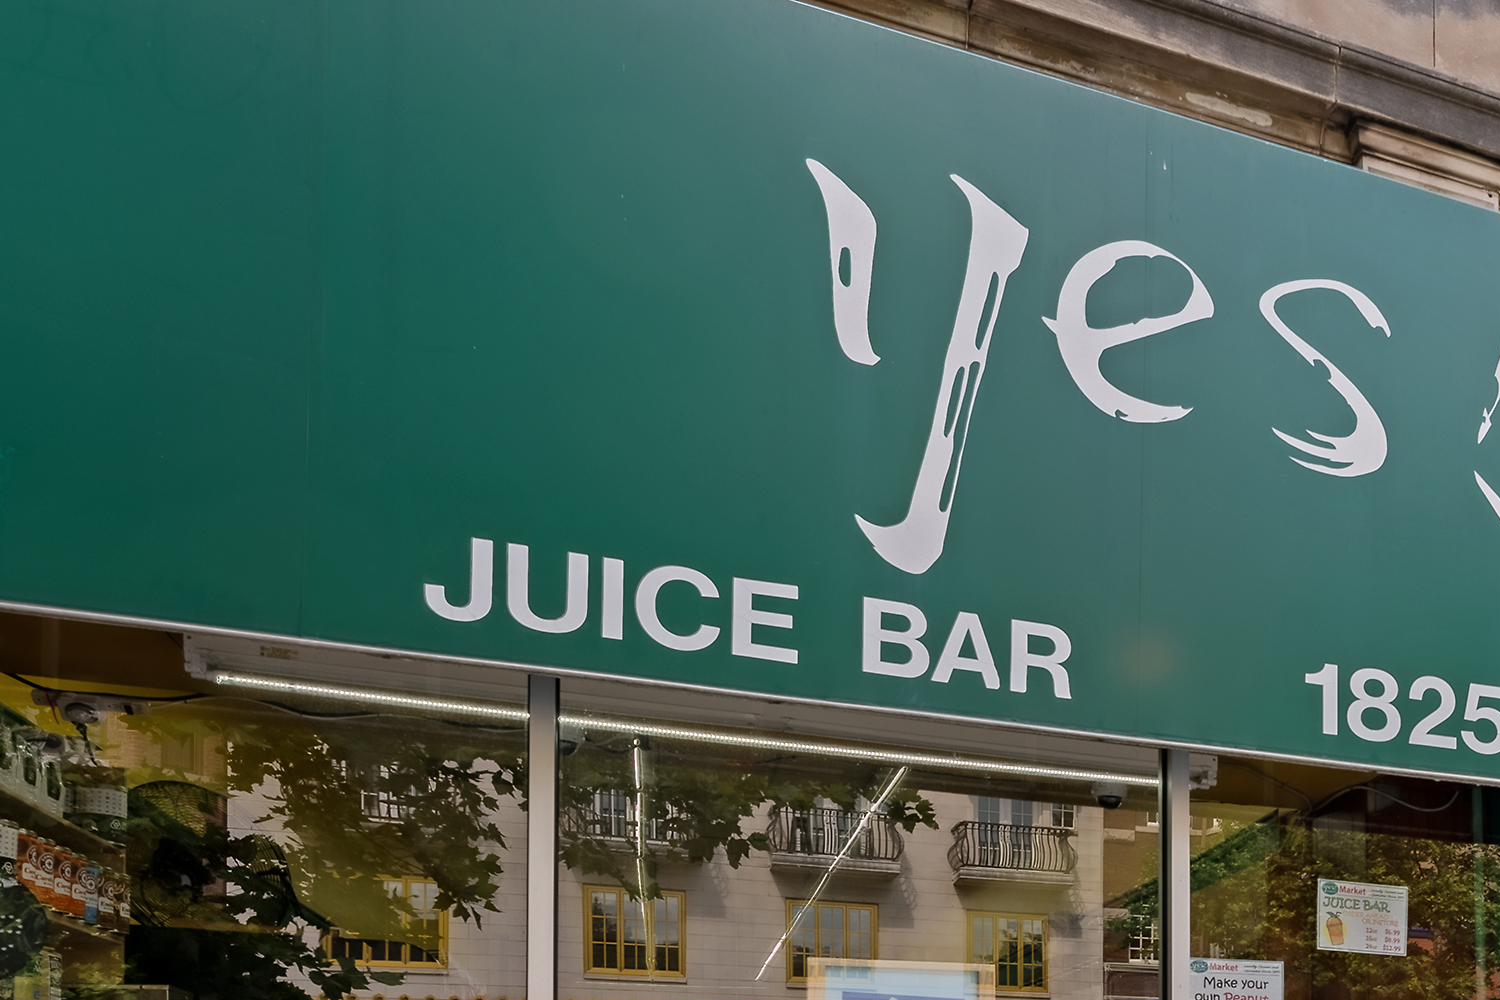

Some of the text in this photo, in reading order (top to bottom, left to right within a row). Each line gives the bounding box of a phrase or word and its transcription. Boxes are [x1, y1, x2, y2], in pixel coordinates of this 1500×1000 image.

[424, 537, 1072, 699] JUICE BAR
[1339, 885, 1366, 896] Market
[1323, 896, 1391, 913] JUICE BAR
[1209, 963, 1239, 971] Market
[1203, 976, 1269, 989] Make your
